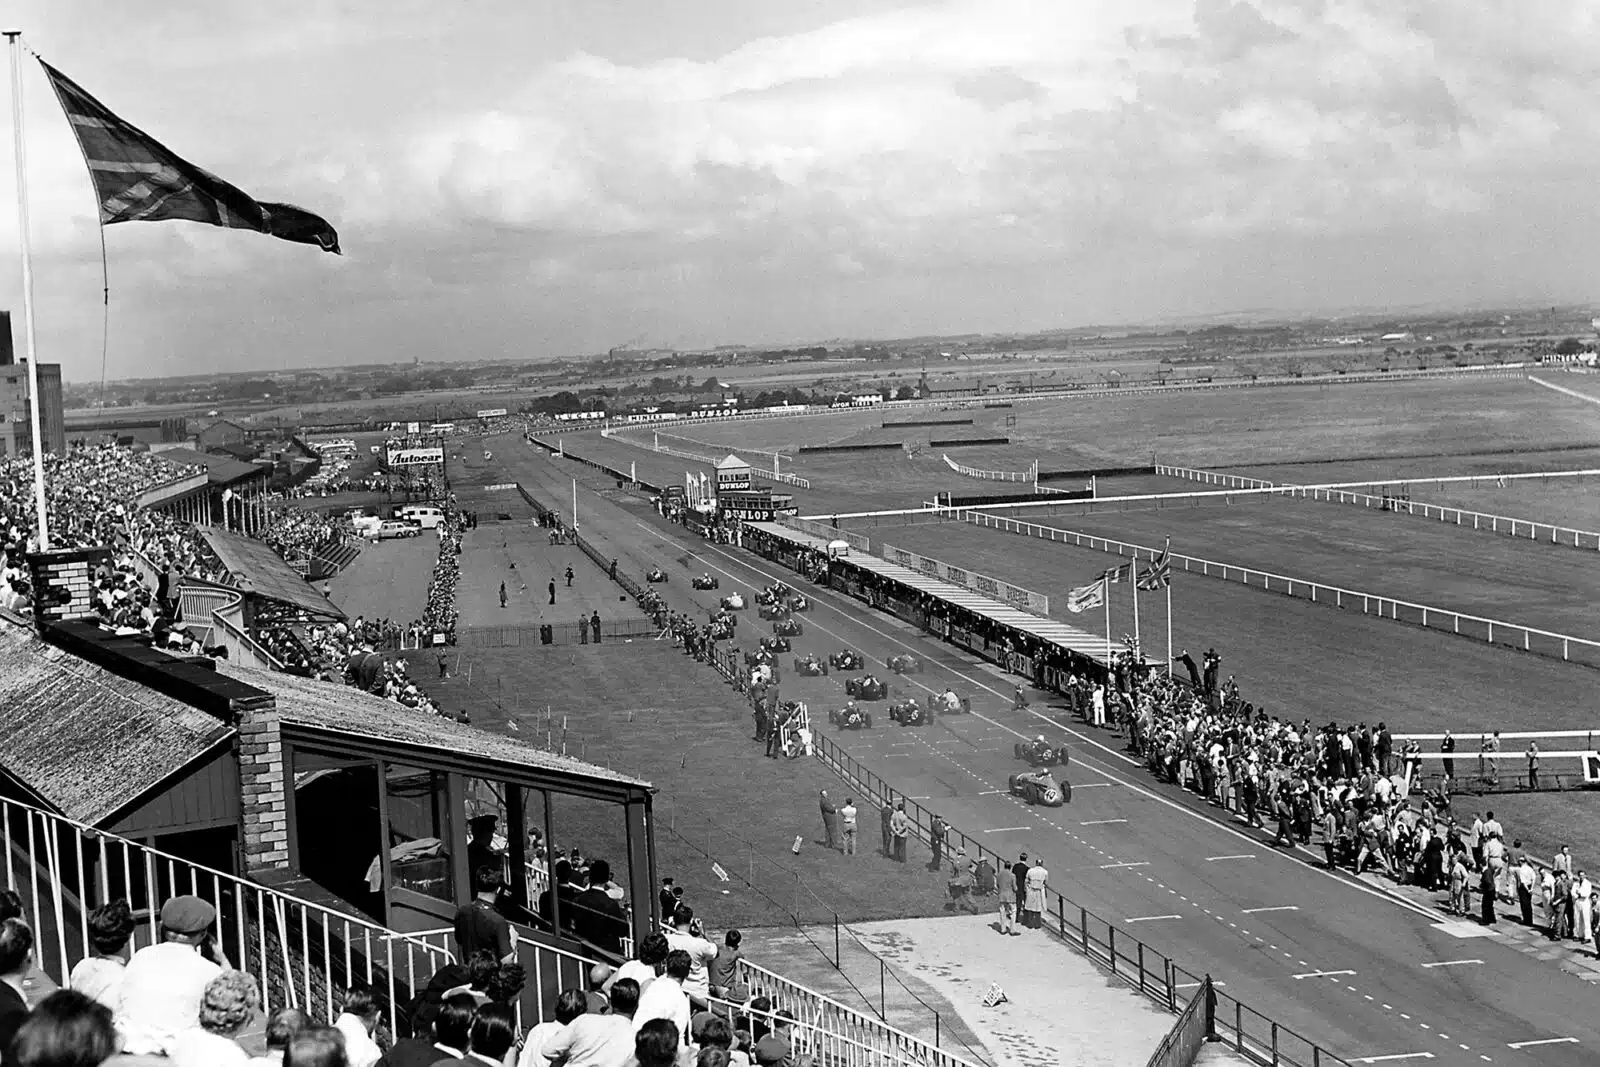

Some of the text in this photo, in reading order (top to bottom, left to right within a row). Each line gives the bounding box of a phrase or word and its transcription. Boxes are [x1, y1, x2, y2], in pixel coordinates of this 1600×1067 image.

[691, 408, 738, 418] DUNLOP
[391, 453, 442, 464] Autocar
[719, 482, 750, 490] DUNLOP
[724, 509, 769, 520] DUNLOP
